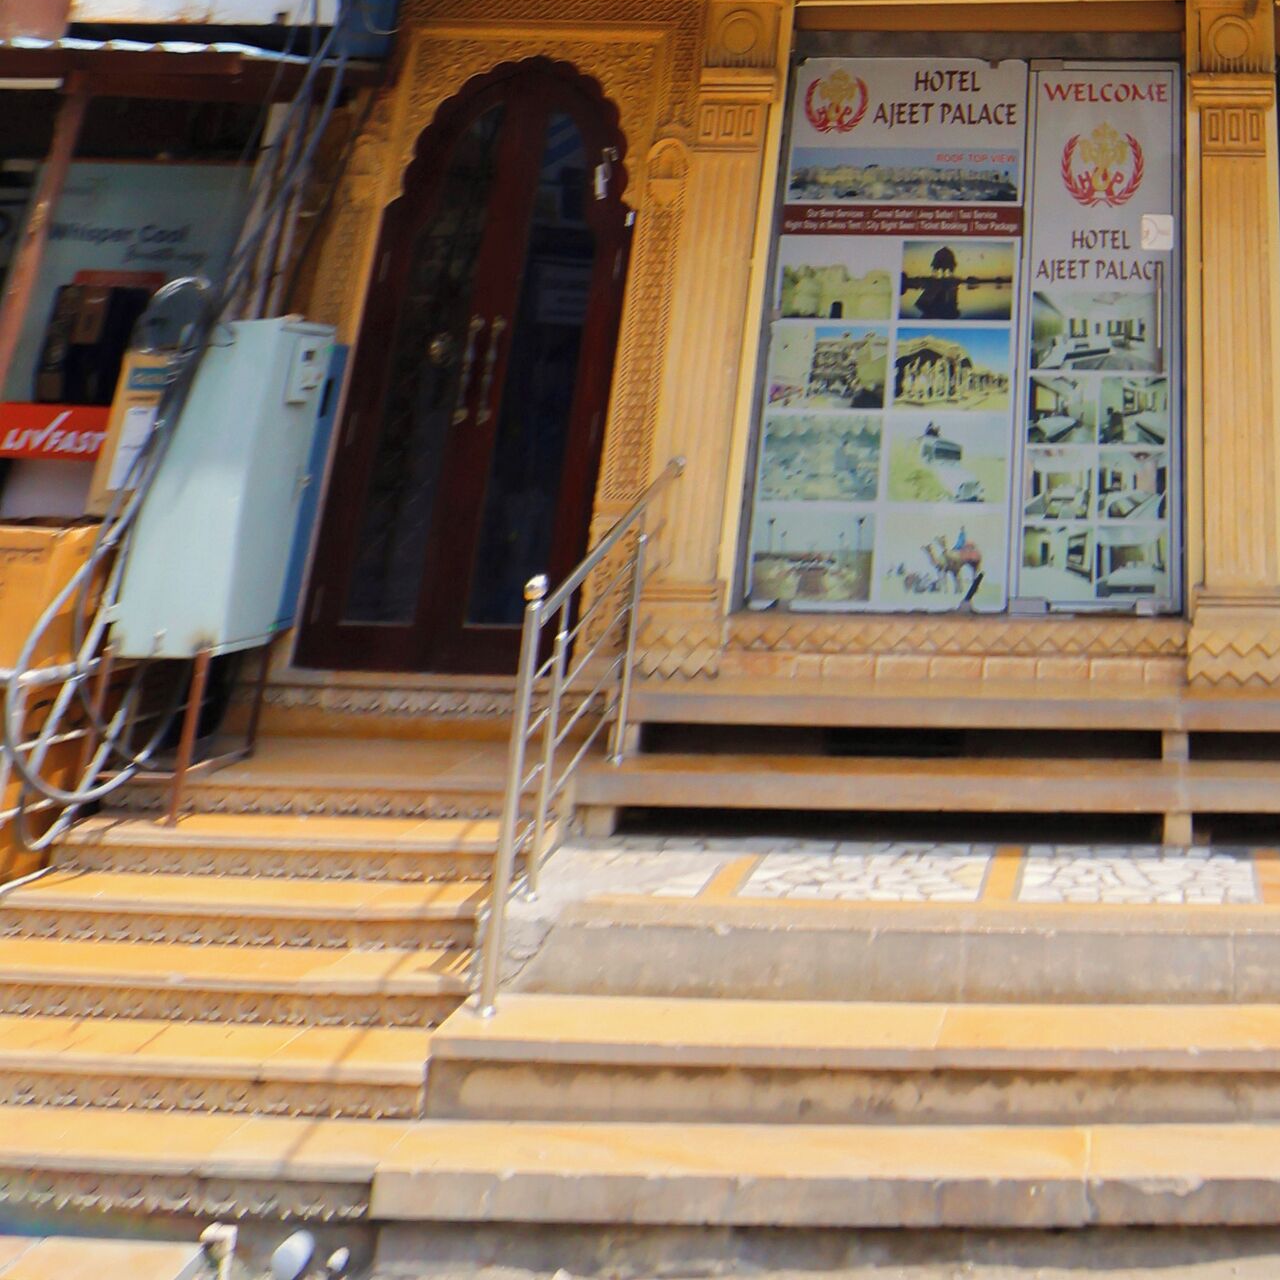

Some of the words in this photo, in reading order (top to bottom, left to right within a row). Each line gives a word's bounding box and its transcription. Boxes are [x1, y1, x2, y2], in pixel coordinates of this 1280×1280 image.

[914, 69, 981, 92] HOTEL
[1043, 83, 1168, 104] WELCOME
[873, 103, 936, 129] AJEET
[939, 103, 1017, 126] PALACE
[936, 153, 964, 163] ROOF
[968, 153, 989, 163] TOP
[991, 153, 1017, 163] VIEW
[1071, 229, 1131, 251] HOTEL
[1036, 260, 1090, 283] AJEET
